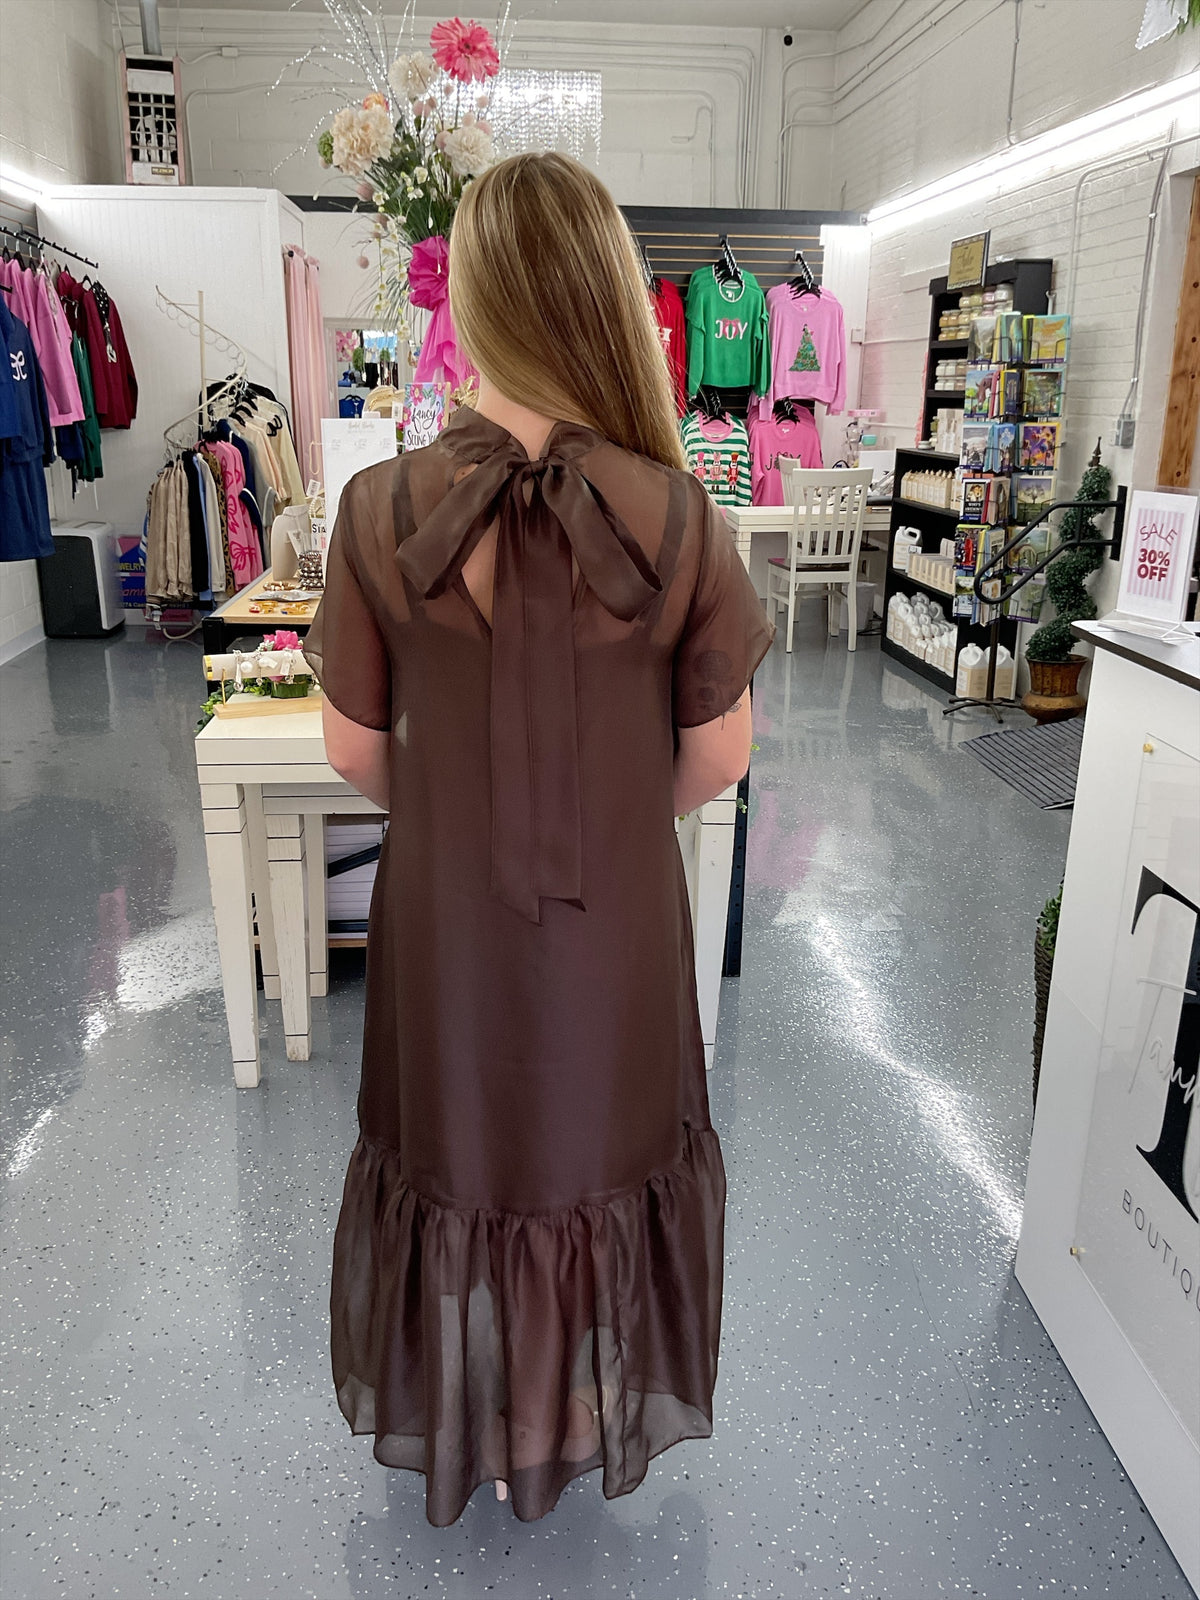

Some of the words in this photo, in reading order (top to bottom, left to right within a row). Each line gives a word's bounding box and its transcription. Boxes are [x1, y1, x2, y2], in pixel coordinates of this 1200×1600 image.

[714, 319, 749, 341] JOY
[411, 401, 441, 434] fancy
[1140, 523, 1178, 546] SALE
[1138, 548, 1170, 567] 30%
[1137, 563, 1168, 581] OFF
[1121, 1188, 1200, 1313] BOUTIQ
